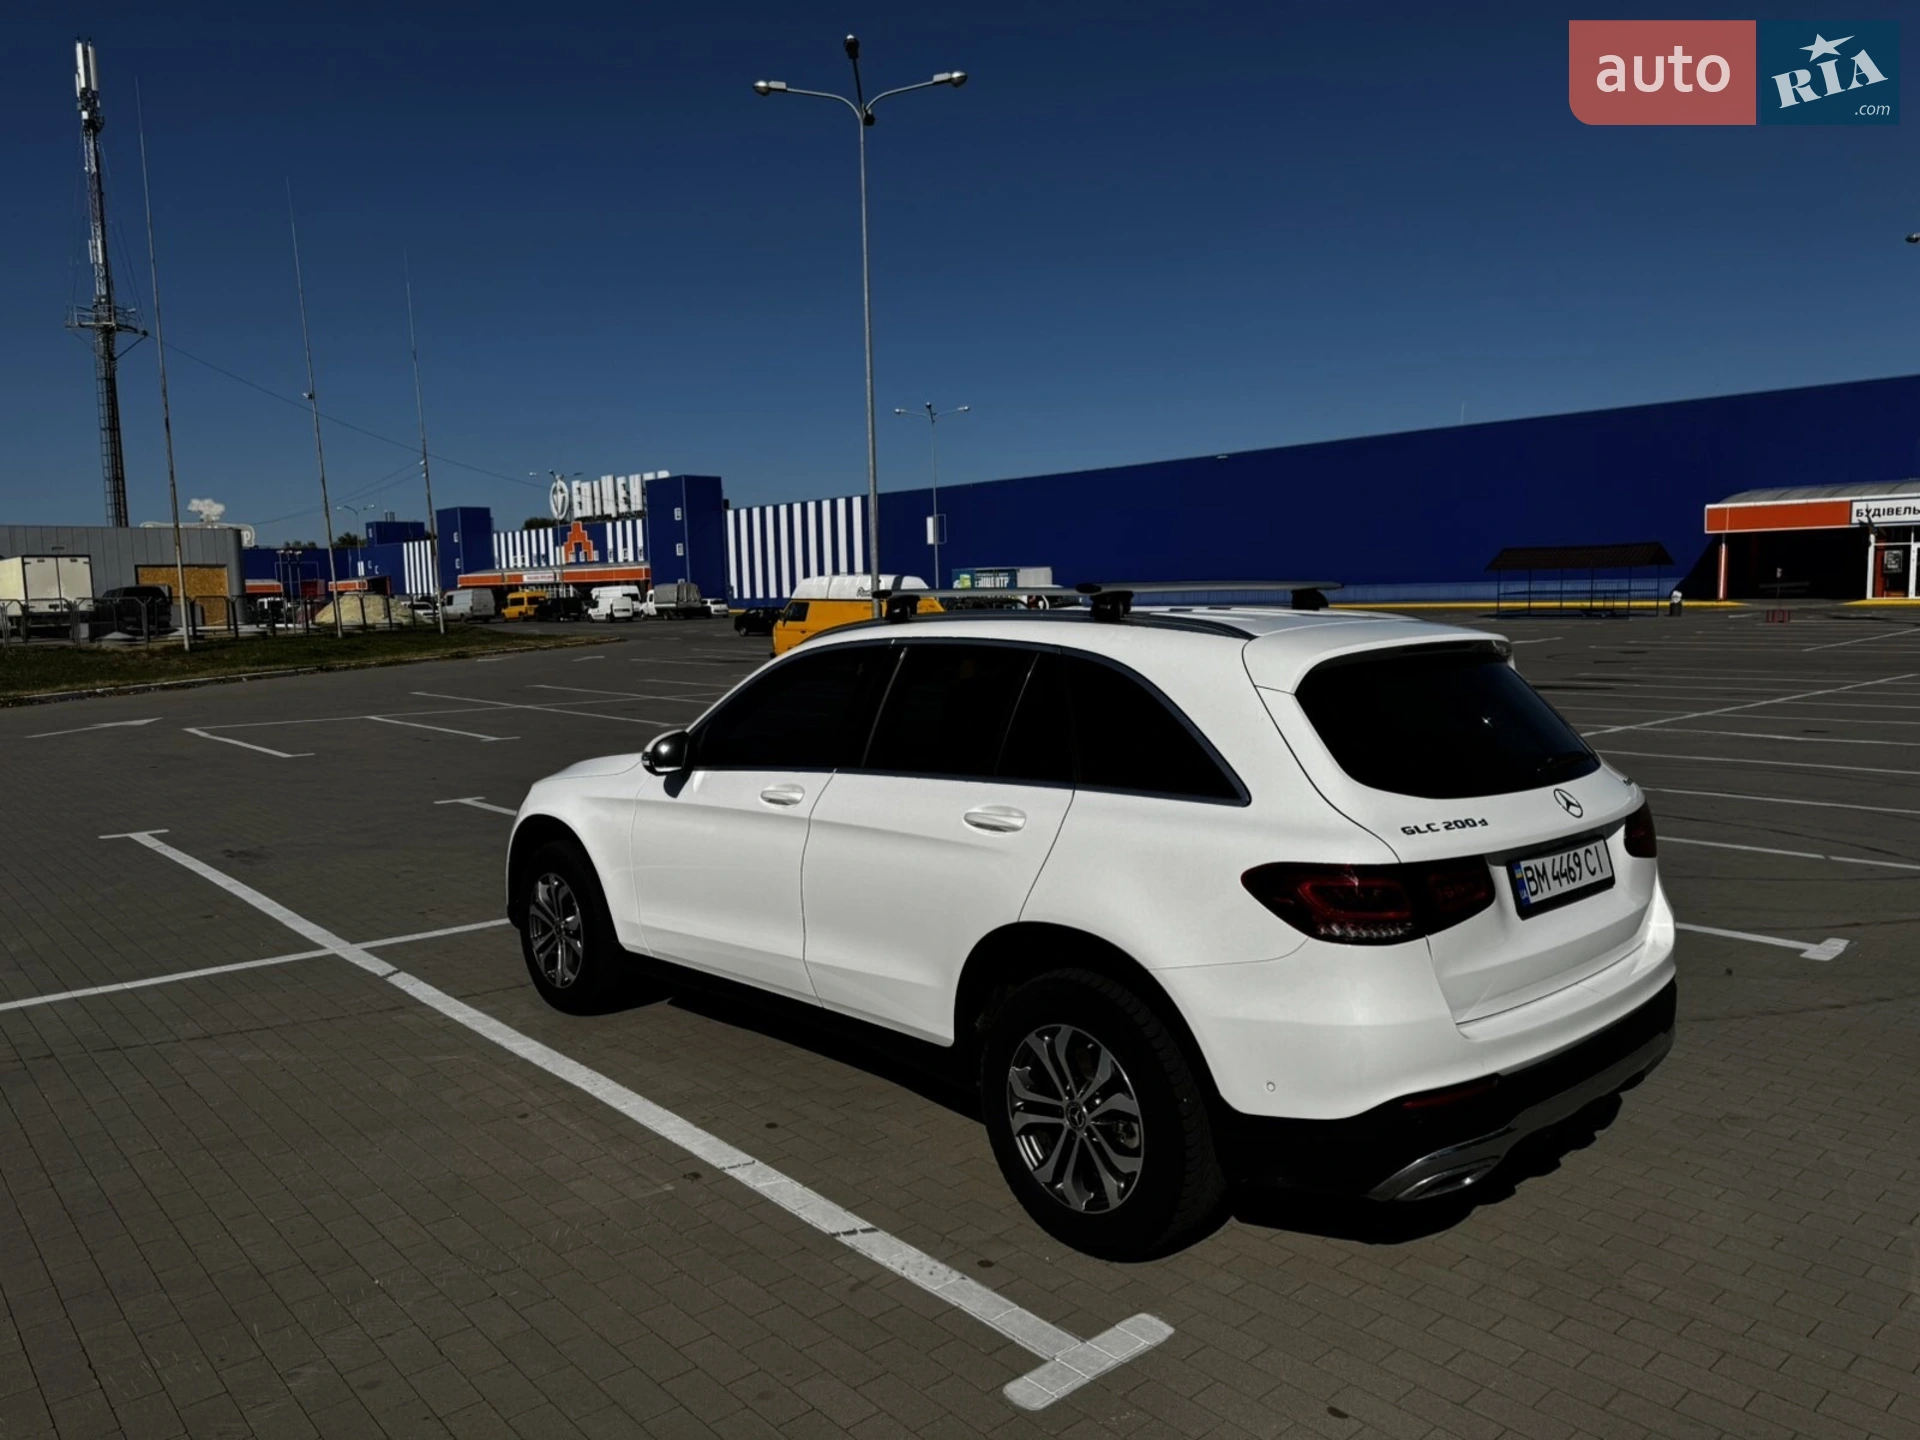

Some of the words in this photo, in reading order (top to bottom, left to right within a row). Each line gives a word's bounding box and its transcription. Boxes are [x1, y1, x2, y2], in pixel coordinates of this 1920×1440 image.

[1400, 822, 1440, 835] GLC
[1523, 861, 1551, 896] BM
[1551, 851, 1583, 887] 4469
